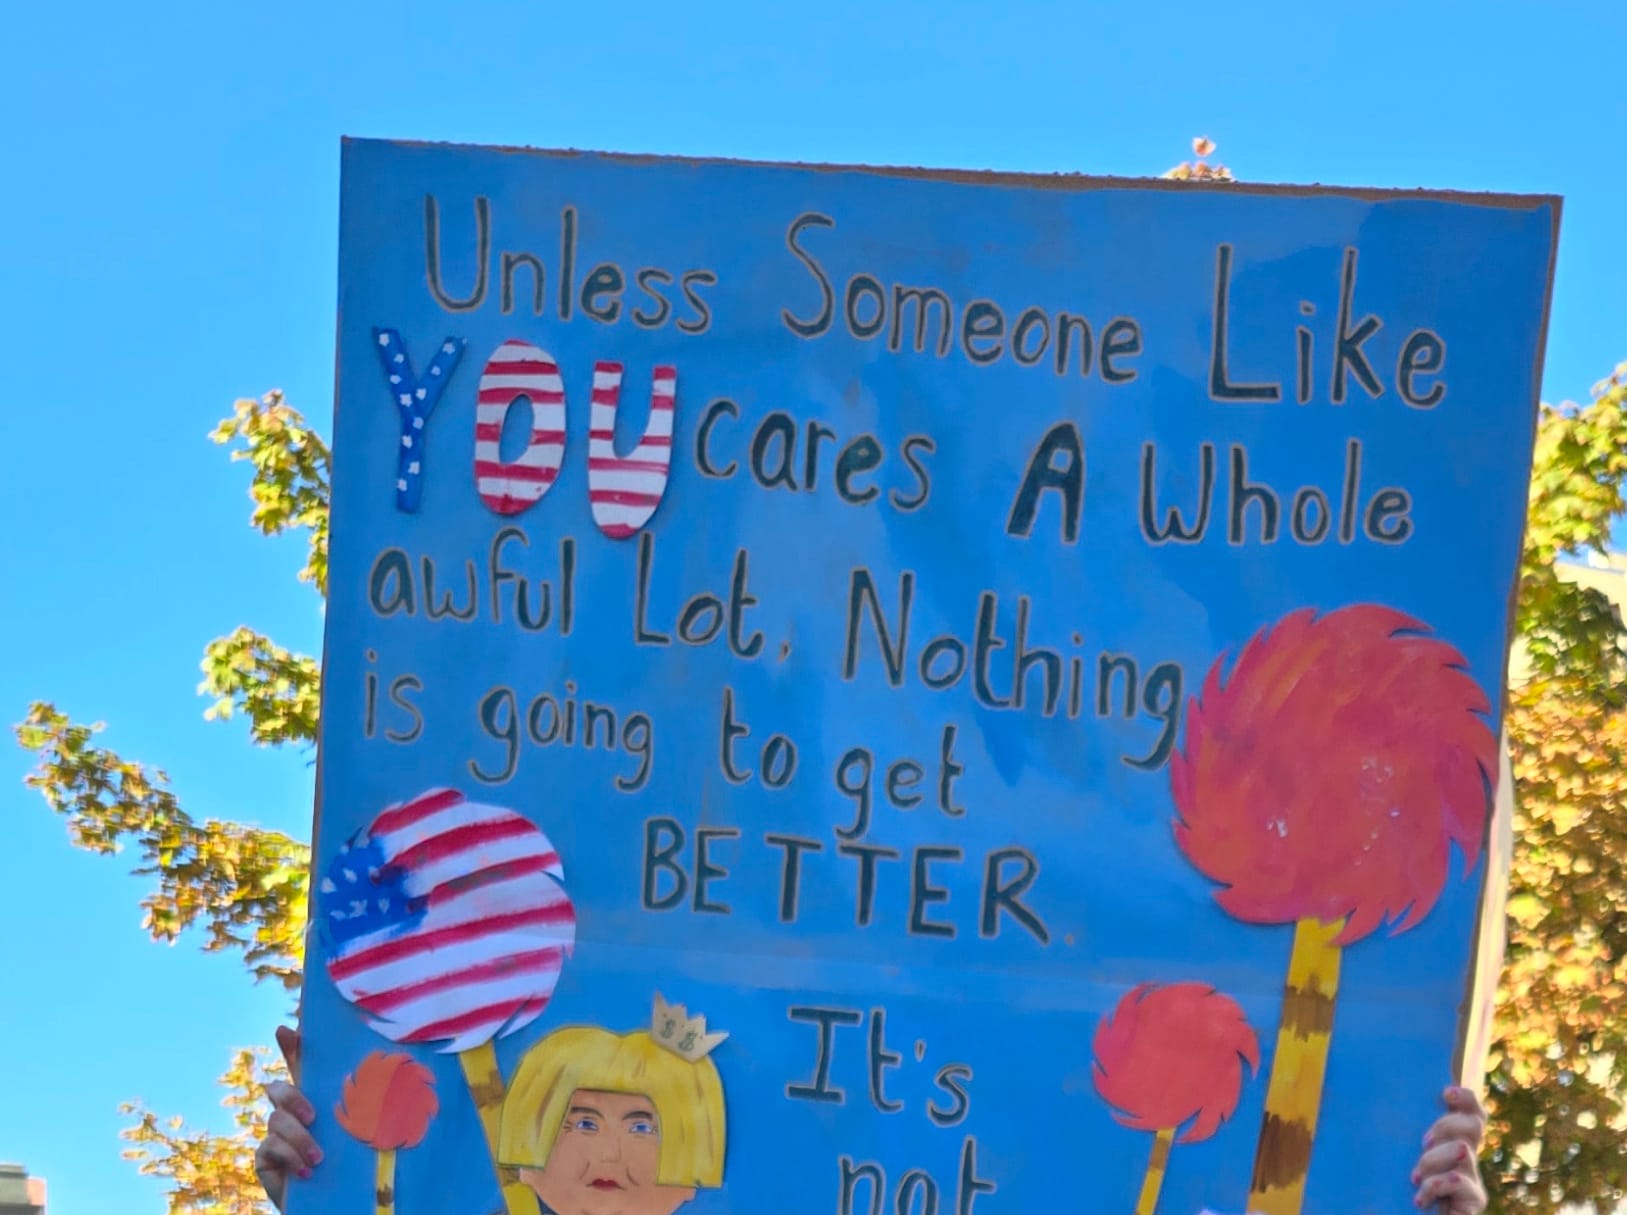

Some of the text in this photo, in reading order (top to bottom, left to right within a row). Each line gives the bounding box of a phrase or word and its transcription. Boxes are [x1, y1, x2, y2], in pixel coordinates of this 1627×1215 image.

[425, 194, 1445, 408] Unless Someone Like
[372, 325, 1414, 545] YOU cares A Whole
[363, 649, 965, 842] is going to get
[369, 527, 575, 636] awful
[842, 566, 1184, 772] Nothing
[786, 1006, 973, 1126] It's
